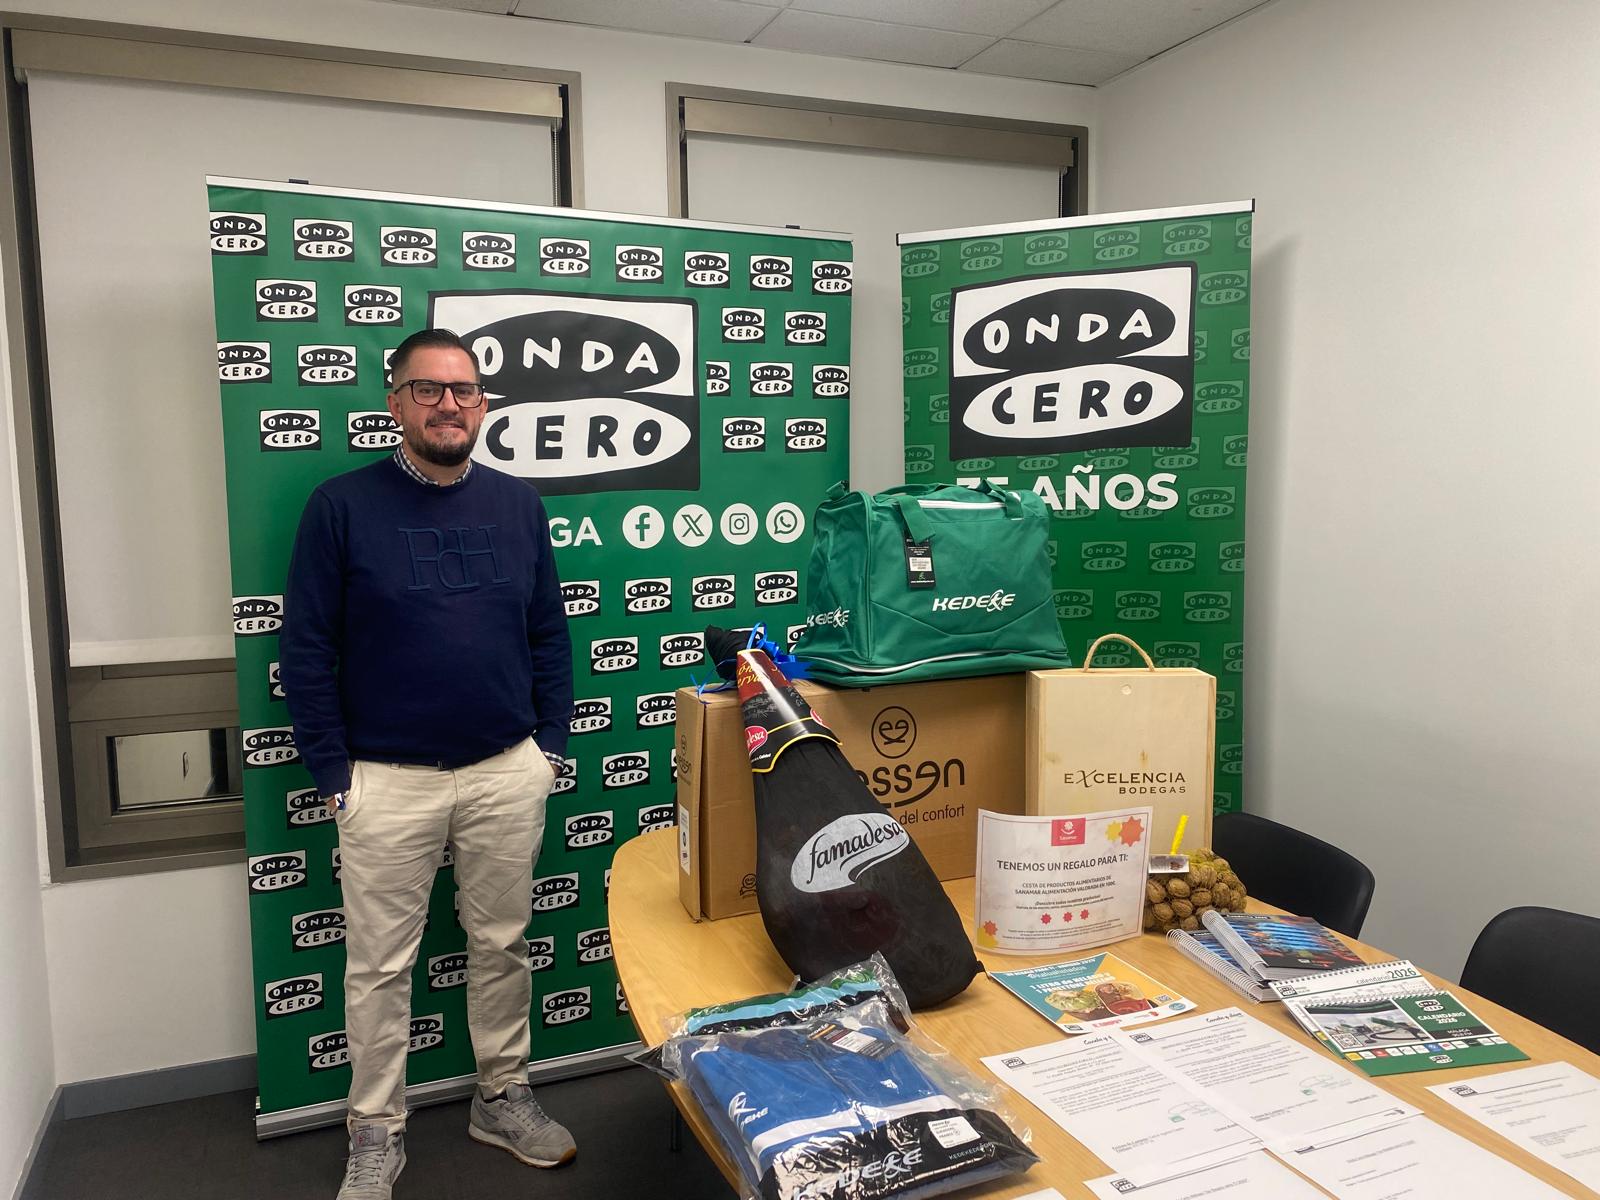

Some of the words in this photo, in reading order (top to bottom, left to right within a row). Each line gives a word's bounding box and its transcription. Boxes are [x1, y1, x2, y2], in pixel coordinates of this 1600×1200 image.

[213, 220, 257, 230] ONDA
[301, 227, 345, 237] ONDA
[1169, 229, 1204, 238] ONDA
[216, 238, 258, 249] CERO
[388, 233, 429, 244] ONDA
[1100, 234, 1132, 244] ONDA
[306, 244, 345, 254] CERO
[470, 239, 508, 249] ONDA
[1030, 239, 1063, 249] ONDA
[1171, 241, 1205, 252] CERO
[547, 246, 583, 255] ONDA
[966, 245, 997, 254] ONDA
[1102, 248, 1134, 258] CERO
[391, 251, 428, 262] CERO
[473, 255, 509, 266] CERO
[622, 253, 656, 262] ONDA
[905, 252, 934, 261] ONDA
[1032, 252, 1063, 263] CERO
[550, 262, 583, 271] CERO
[691, 259, 727, 268] ONDA
[756, 262, 786, 271] ONDA
[968, 258, 997, 268] CERO
[625, 268, 657, 277] CERO
[818, 267, 848, 276] ONDA
[906, 265, 934, 274] CERO
[693, 273, 723, 282] CERO
[757, 276, 786, 286] CERO
[1205, 278, 1240, 287] ONDA
[819, 281, 851, 291] CERO
[265, 288, 308, 297] ONDA
[1207, 292, 1239, 301] CERO
[353, 293, 394, 303] ONDA
[268, 305, 308, 315] CERO
[355, 310, 393, 320] CERO
[728, 314, 759, 323] ONDA
[791, 318, 821, 326] ONDA
[730, 328, 759, 338] CERO
[983, 308, 1153, 354] ONDA
[793, 332, 821, 341] CERO
[218, 350, 262, 359] ONDA
[306, 353, 348, 363] ONDA
[472, 336, 659, 375] ONDA
[222, 366, 262, 376] CERO
[309, 369, 348, 379] CERO
[756, 369, 786, 378] ONDA
[818, 371, 845, 380] ONDA
[907, 367, 932, 375] CERO
[758, 383, 787, 392] CERO
[820, 385, 848, 394] CERO
[1202, 387, 1235, 396] ONDA
[992, 380, 1153, 425] CERO
[1204, 400, 1236, 411] CERO
[268, 417, 310, 427] ONDA
[354, 419, 397, 429] ONDA
[729, 424, 759, 432] ONDA
[791, 424, 821, 432] ONDA
[272, 434, 312, 444] CERO
[359, 434, 399, 444] CERO
[485, 415, 662, 460] CERO
[730, 438, 759, 446] CERO
[793, 438, 821, 447] CERO
[1024, 459, 1053, 468] CERO
[1093, 458, 1123, 467] CERO
[1162, 457, 1193, 466] CERO
[1032, 465, 1178, 511] AÑOS
[1195, 505, 1228, 515] CERO
[1088, 547, 1120, 556] ONDA
[1156, 548, 1188, 556] ONDA
[1090, 560, 1121, 569] CERO
[1157, 561, 1189, 570] CERO
[698, 581, 729, 590] ONDA
[761, 577, 791, 586] ONDA
[631, 584, 665, 594] ONDA
[700, 595, 729, 604] CERO
[763, 590, 791, 599] CERO
[1056, 594, 1086, 602] ONDA
[634, 599, 664, 608] CERO
[1121, 596, 1154, 604] ONDA
[1190, 596, 1224, 606] ONDA
[233, 604, 275, 614] ONDA
[569, 602, 593, 611] ERO
[1058, 608, 1088, 616] CERO
[1124, 609, 1154, 618] CERO
[1192, 610, 1224, 619] CERO
[237, 621, 275, 631] CERO
[597, 644, 631, 653] ONDA
[666, 639, 698, 648] ONDA
[600, 657, 631, 667] CERO
[669, 652, 698, 662] CERO
[643, 698, 675, 708] ONDA
[645, 711, 675, 722] CERO
[572, 717, 604, 729] CERO
[250, 735, 293, 745] ONDA
[254, 750, 293, 761] CERO
[609, 760, 643, 770] ONDA
[611, 771, 643, 782] CERO
[1064, 770, 1185, 788] EXCELENCIA
[1119, 786, 1186, 794] BODEGAS
[900, 809, 918, 825] del
[923, 804, 965, 821] confort
[572, 819, 606, 830] ONDA
[574, 831, 607, 843] CERO
[807, 819, 904, 884] famadesa
[256, 860, 298, 871] ONDA
[997, 860, 1044, 871] TENEMOS
[1048, 862, 1060, 871] UN
[1063, 859, 1095, 870] REGALO
[1098, 855, 1117, 866] PARA
[1119, 853, 1128, 862] TI:
[259, 874, 298, 887] CERO
[537, 881, 571, 892] ONDA
[539, 893, 572, 907] CERO
[300, 916, 340, 928] ONDA
[303, 930, 341, 944] CERO
[1389, 968, 1416, 979] 2026
[273, 981, 314, 996] ONDA
[276, 996, 314, 1010] CERO
[549, 994, 584, 1006] ONDA
[551, 1007, 584, 1019] CERO
[1418, 1012, 1466, 1020] CALENDARIO
